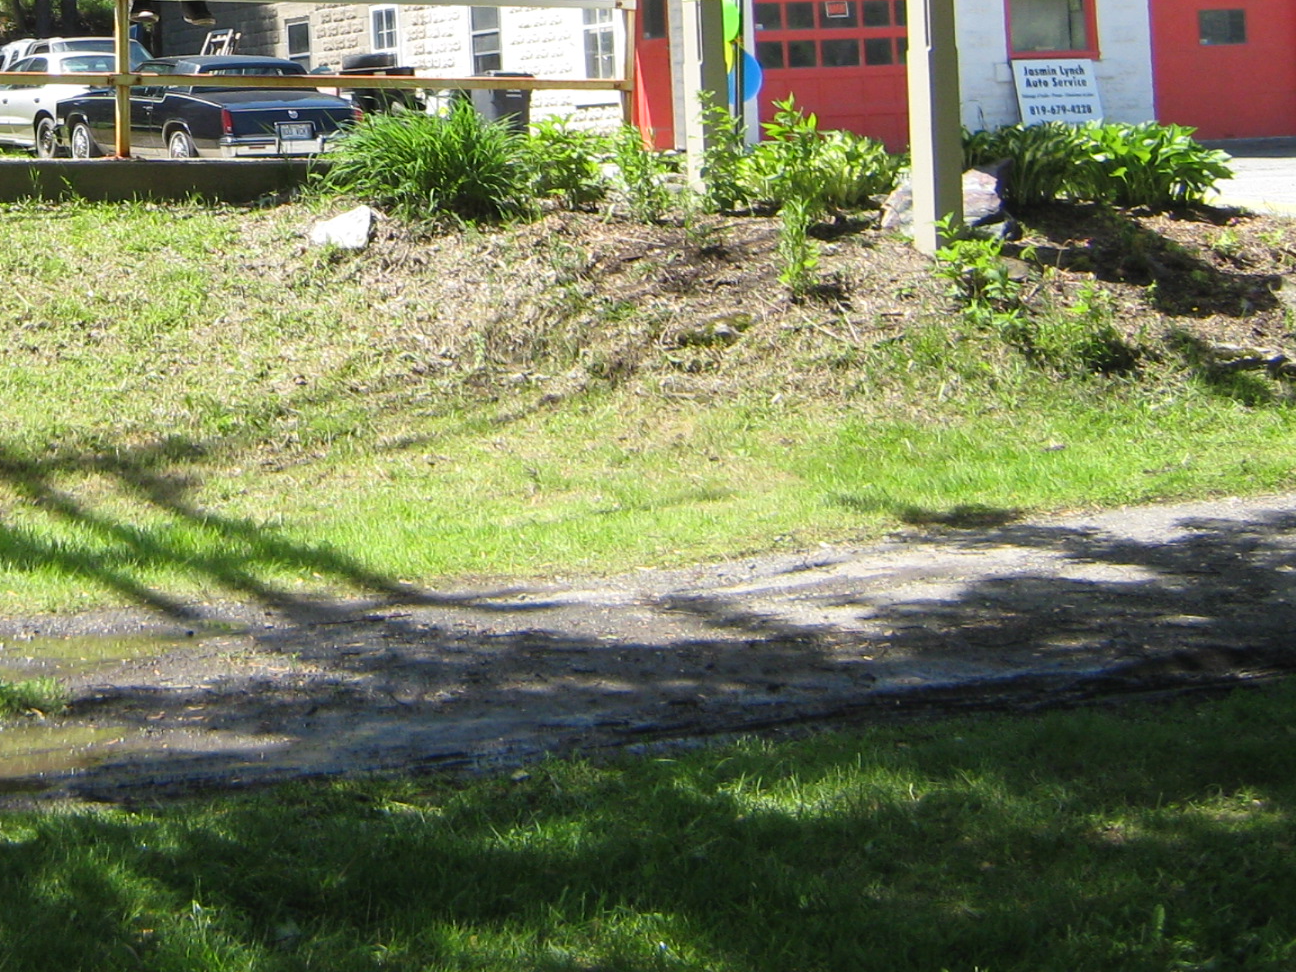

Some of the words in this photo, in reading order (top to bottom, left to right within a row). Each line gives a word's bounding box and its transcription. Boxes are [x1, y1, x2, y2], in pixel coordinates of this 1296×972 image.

[1024, 66, 1057, 76] Jasmin
[1059, 65, 1085, 77] Lynch
[1026, 78, 1049, 87] Auto
[1052, 77, 1087, 87] Service
